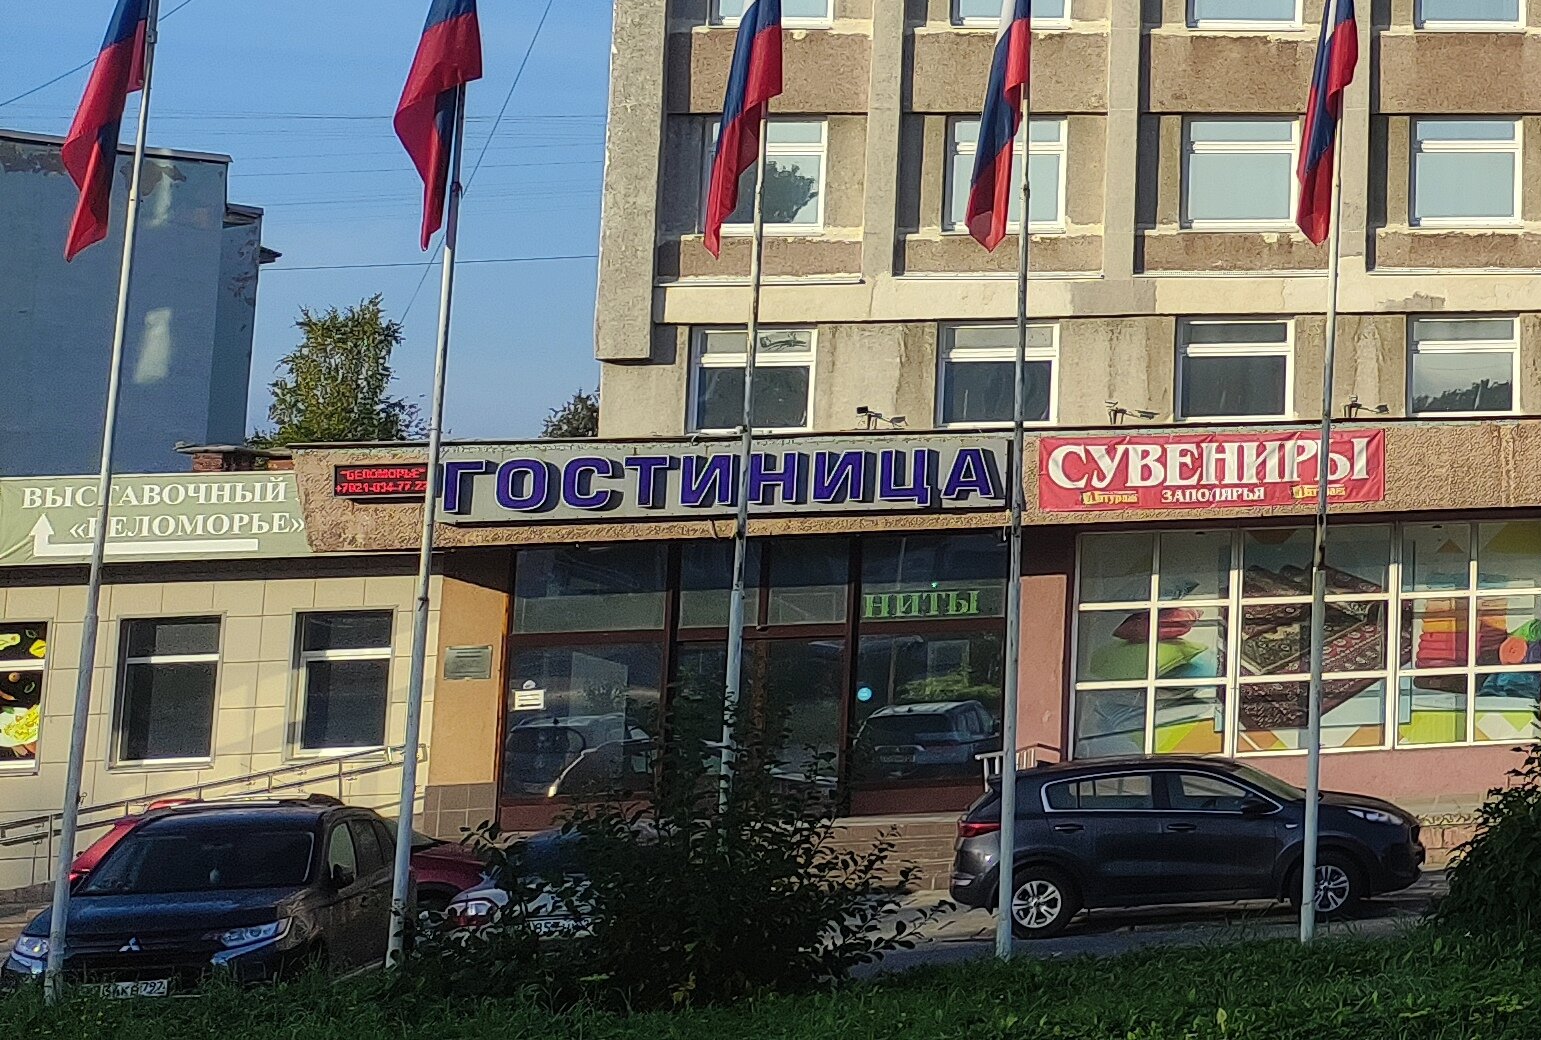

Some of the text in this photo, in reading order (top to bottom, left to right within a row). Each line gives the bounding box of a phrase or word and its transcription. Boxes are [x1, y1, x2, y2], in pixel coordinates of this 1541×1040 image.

[1047, 436, 1371, 489] СУВЕНИРЫ
[22, 477, 288, 509] ВЫСТАВОЧНЫЙ
[441, 447, 997, 514] ГОСТИНИЦА
[1161, 487, 1265, 504] ЗАПОЛЯРЬЯ
[863, 590, 980, 618] НИТЫ
